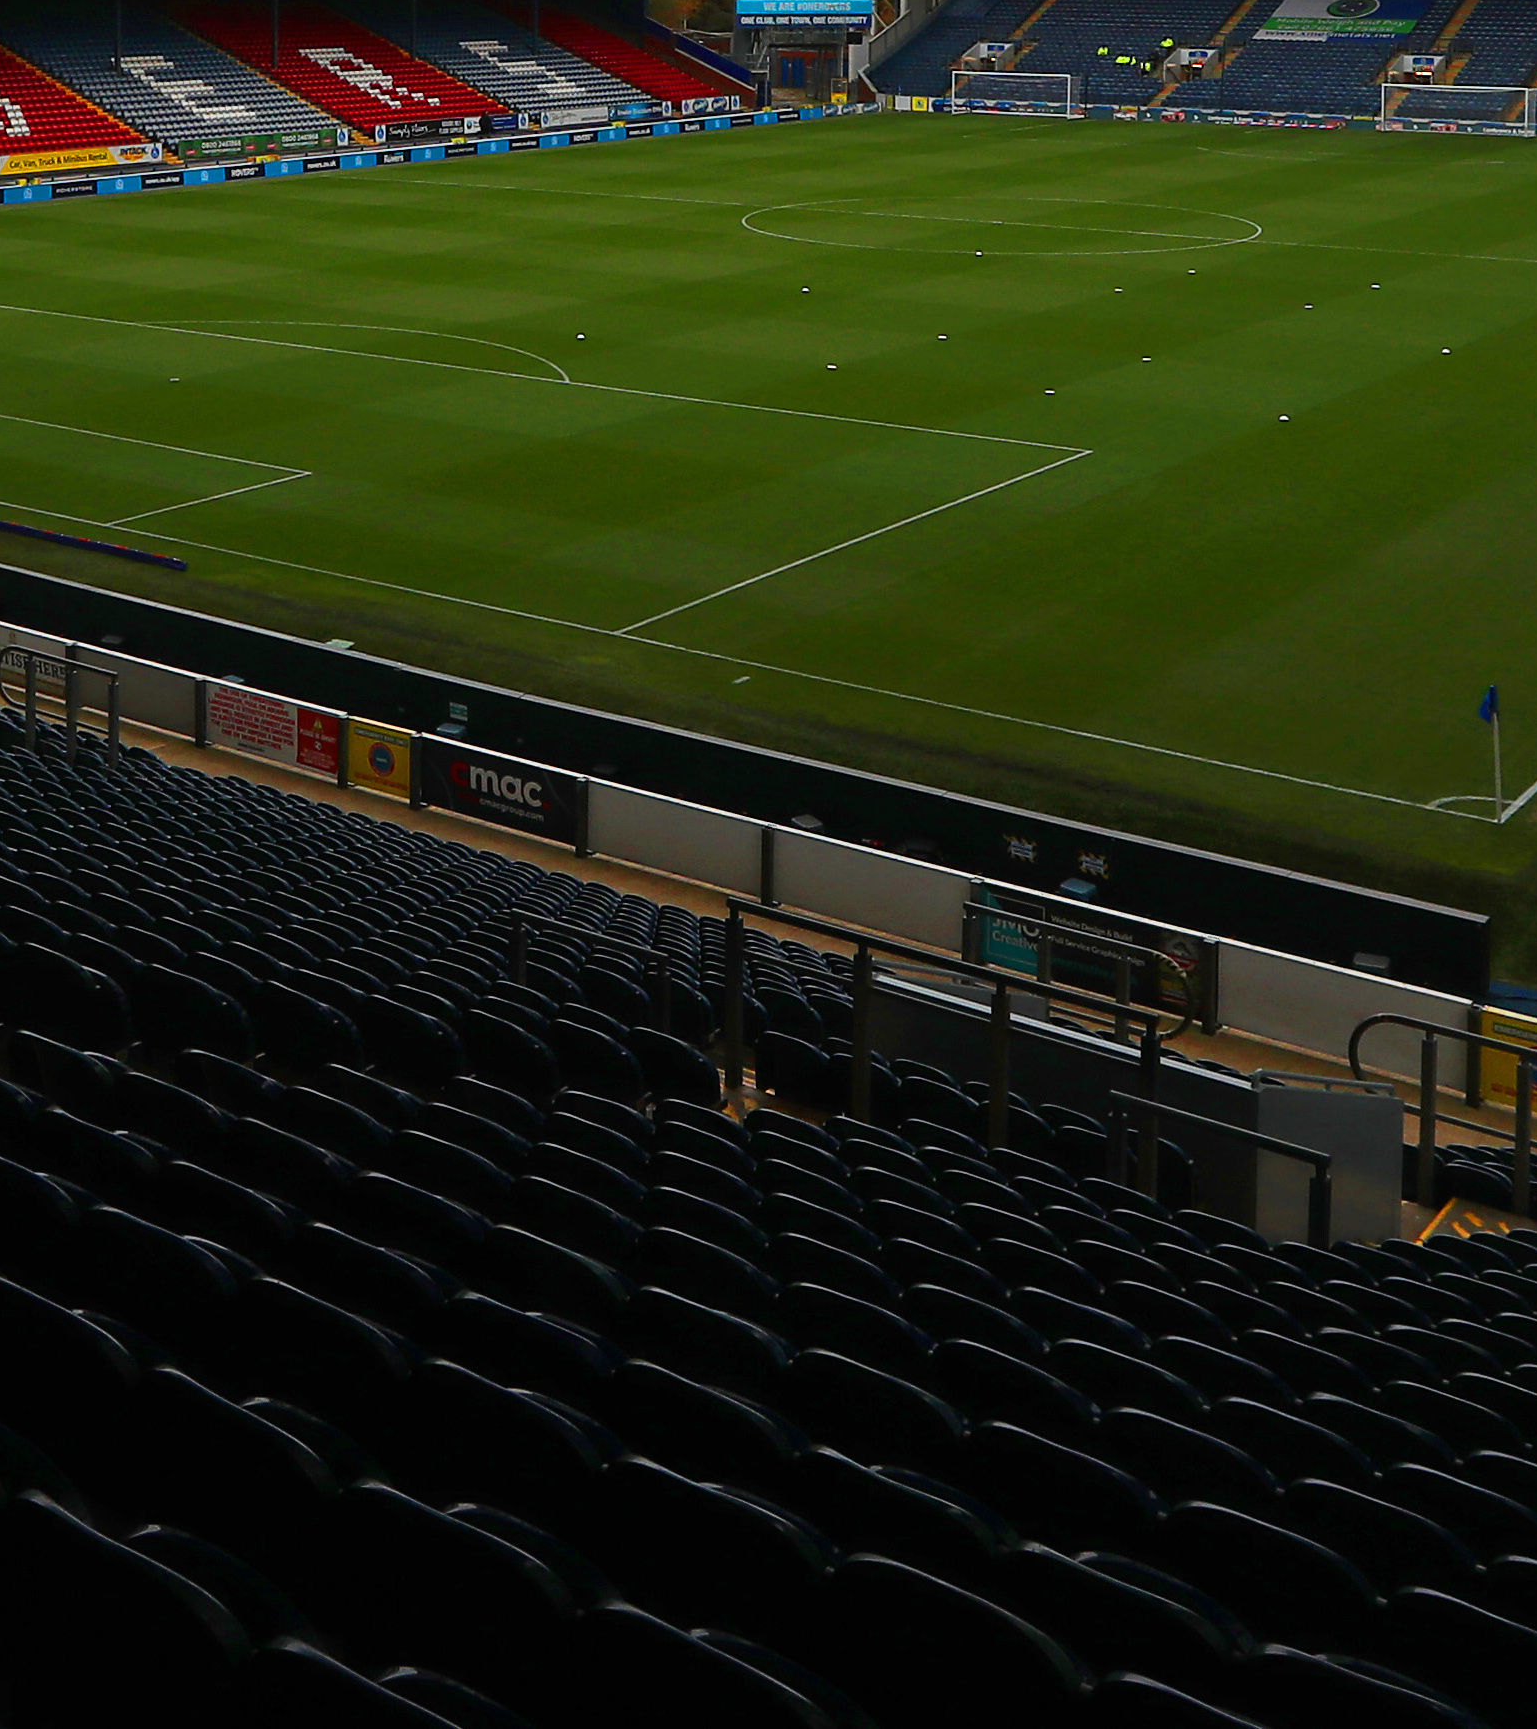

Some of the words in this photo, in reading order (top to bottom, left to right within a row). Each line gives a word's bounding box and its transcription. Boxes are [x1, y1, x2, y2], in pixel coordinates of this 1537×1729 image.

[827, 17, 868, 25] COMMUNITY
[120, 147, 147, 155] INTACK
[39, 158, 55, 166] Truck
[57, 157, 62, 165] &
[63, 155, 88, 164] Minibus
[88, 153, 108, 162] Rental
[1051, 915, 1081, 929] Website
[1081, 922, 1106, 936] Design
[1106, 928, 1112, 936] &
[1113, 930, 1134, 943] Build
[1065, 938, 1091, 952] Service
